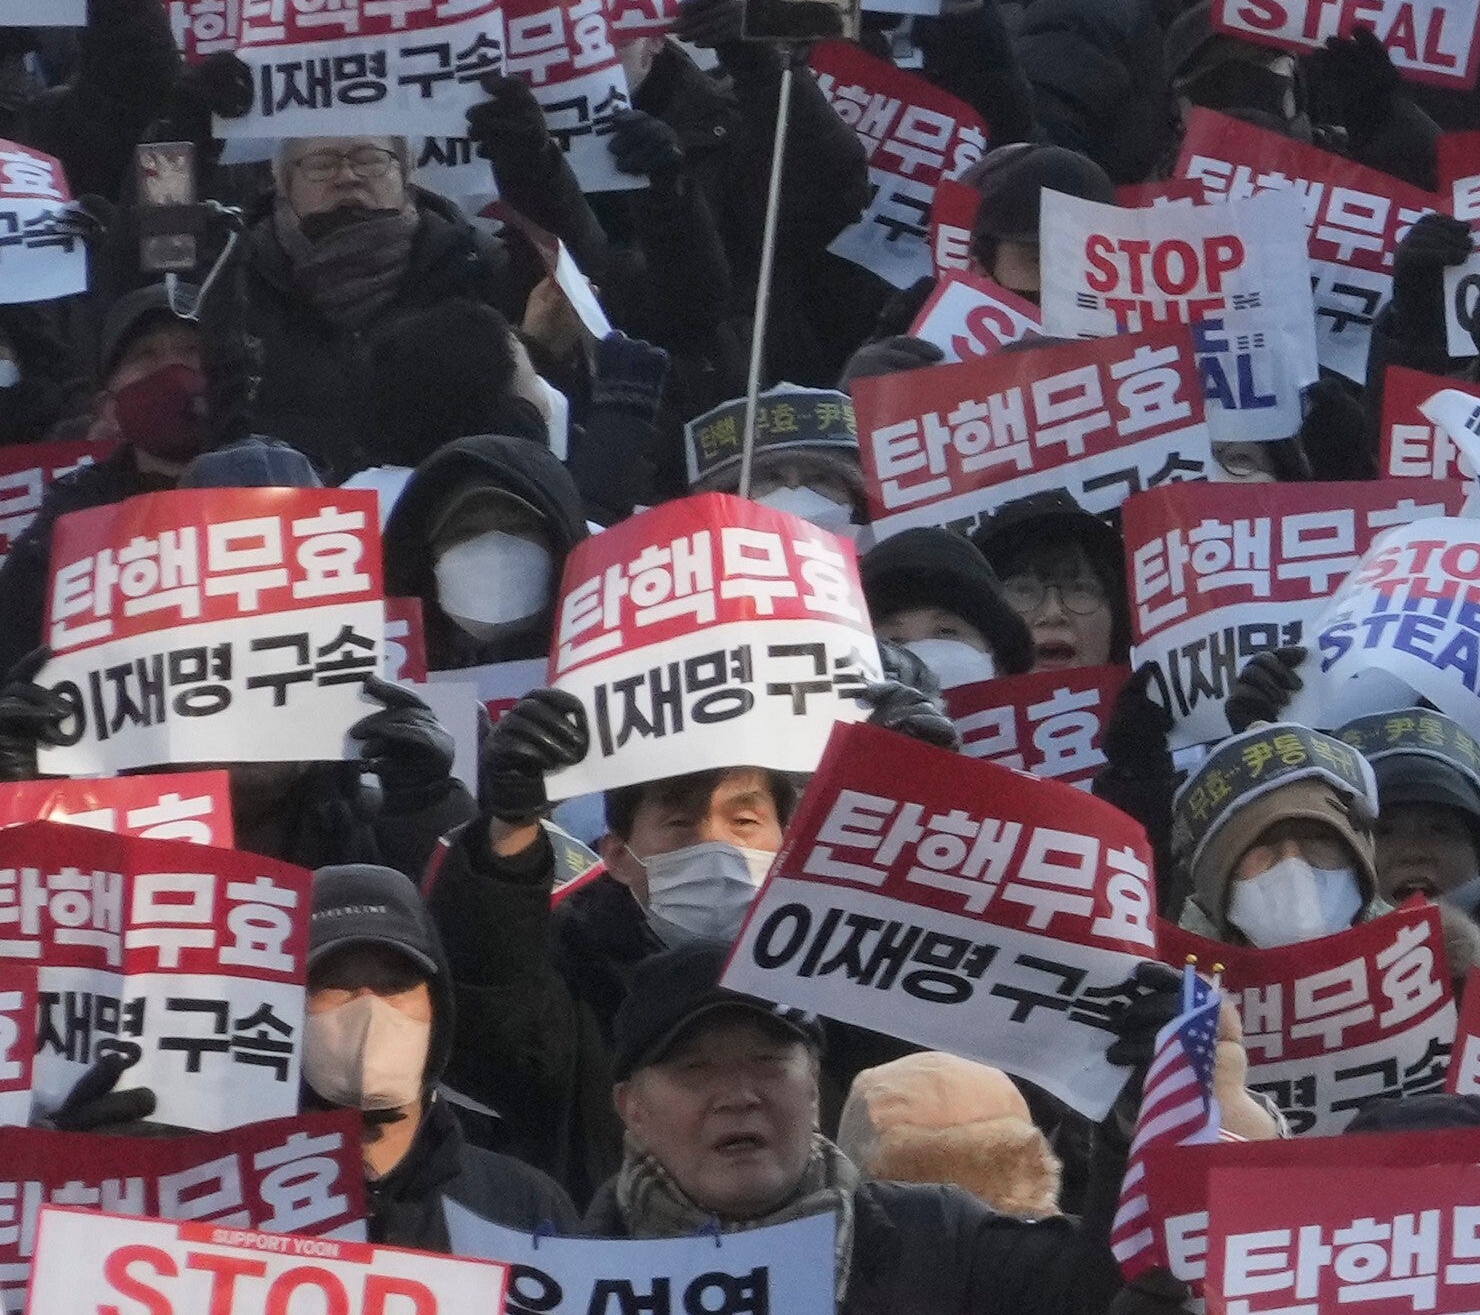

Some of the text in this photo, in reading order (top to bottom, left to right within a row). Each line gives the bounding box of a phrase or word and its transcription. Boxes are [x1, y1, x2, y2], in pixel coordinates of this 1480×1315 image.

[1086, 235, 1243, 293] STOP
[873, 346, 1191, 512] 탄핵무효
[51, 508, 371, 645] 탄핵무효
[559, 526, 863, 672] 탄핵무효
[805, 791, 1153, 947] 탄핵무효
